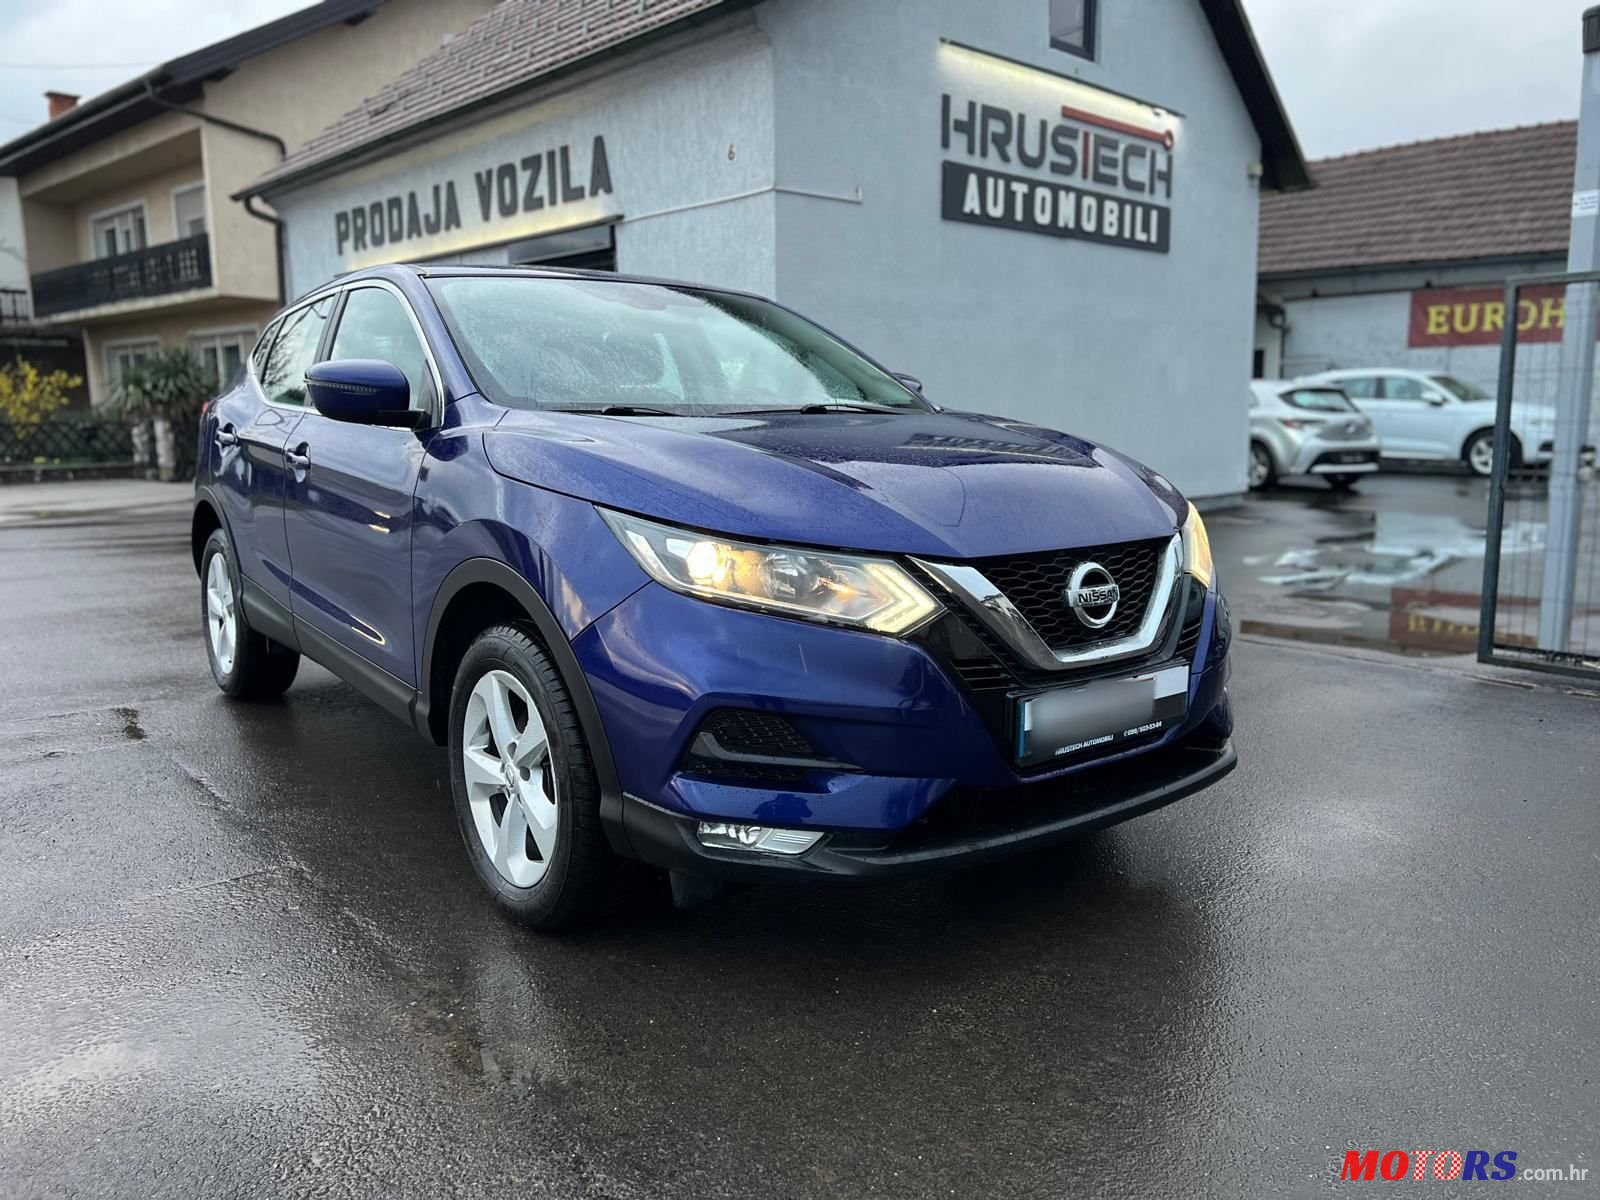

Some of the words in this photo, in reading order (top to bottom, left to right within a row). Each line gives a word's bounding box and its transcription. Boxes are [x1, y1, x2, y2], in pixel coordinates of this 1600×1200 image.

[727, 143, 736, 161] 6
[941, 93, 1173, 199] HRUSTECH
[335, 180, 461, 255] PRODAJA
[474, 135, 613, 222] VOZILA
[962, 172, 1159, 244] AUTOMOBILI
[1078, 588, 1119, 603] NISSAN
